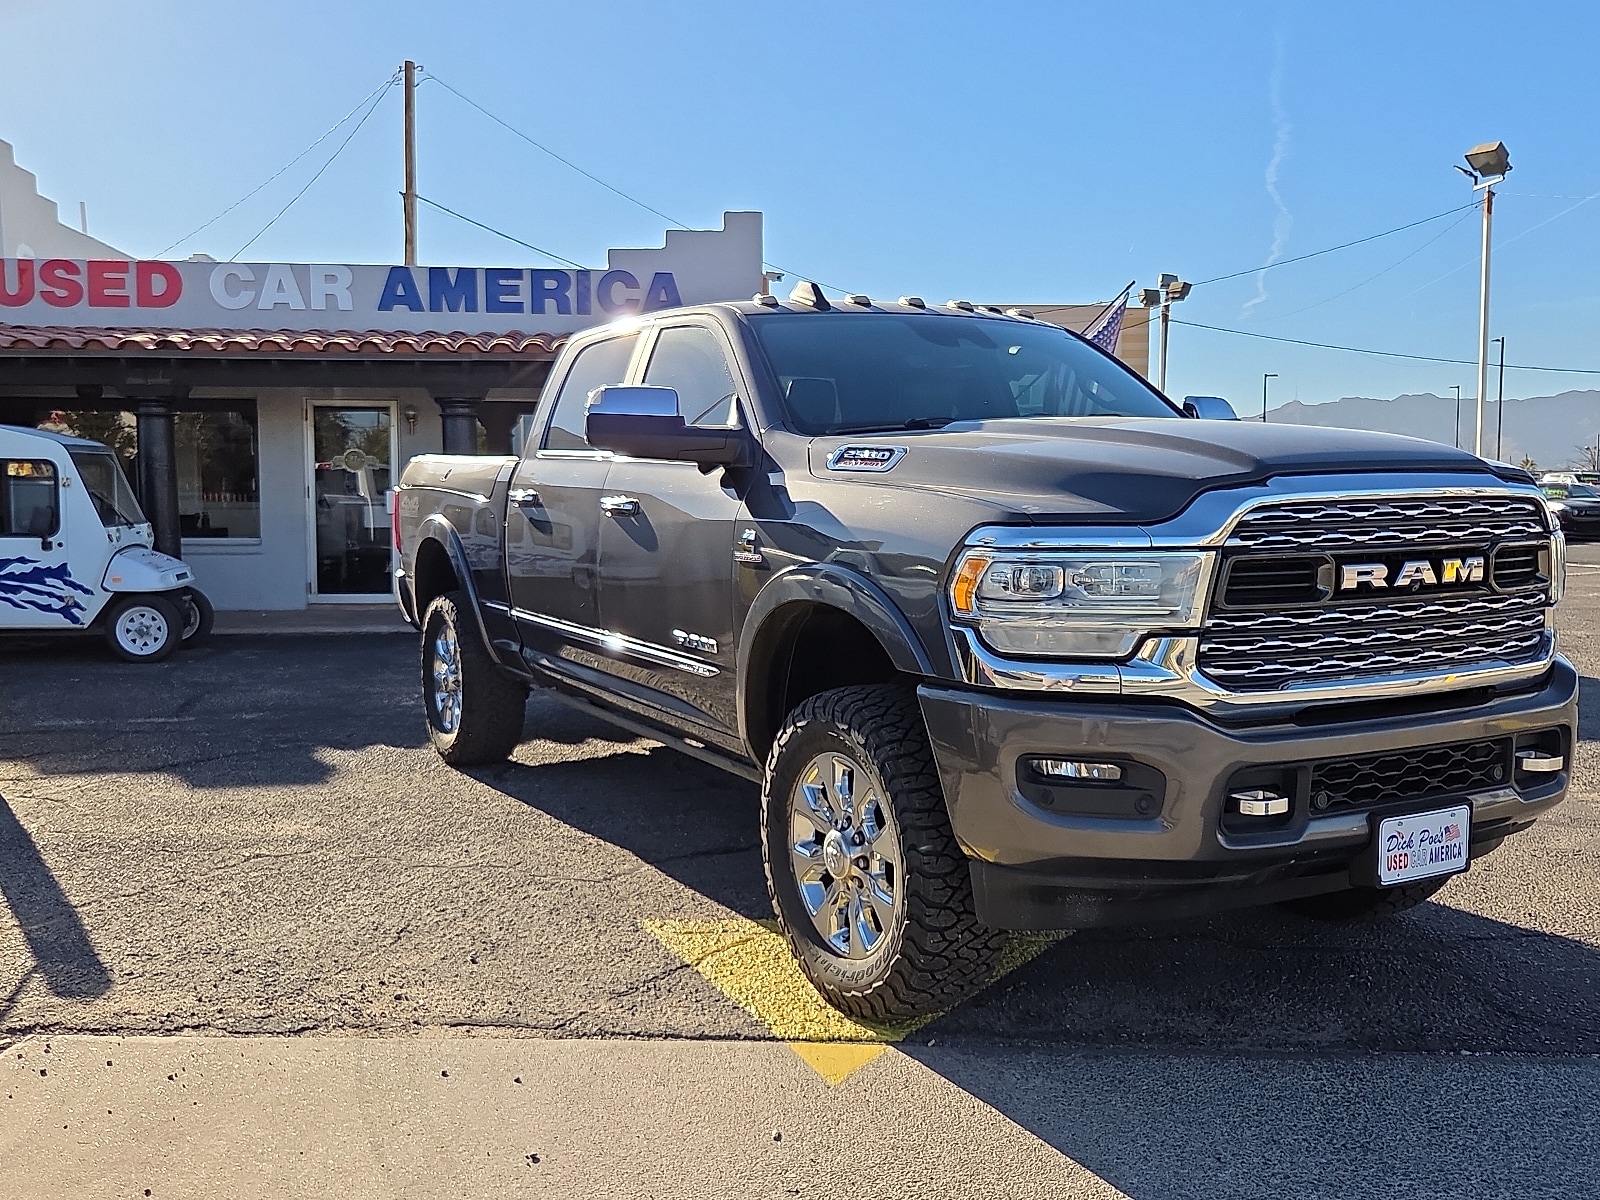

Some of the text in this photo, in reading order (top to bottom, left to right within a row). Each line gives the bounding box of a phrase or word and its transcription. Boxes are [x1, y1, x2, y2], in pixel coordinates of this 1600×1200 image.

[0, 258, 682, 315] USED CAR AMERICA
[1341, 556, 1484, 590] RAM
[1386, 831, 1415, 853] Dick
[1386, 852, 1409, 872] USED
[1428, 842, 1462, 865] AMERICA
